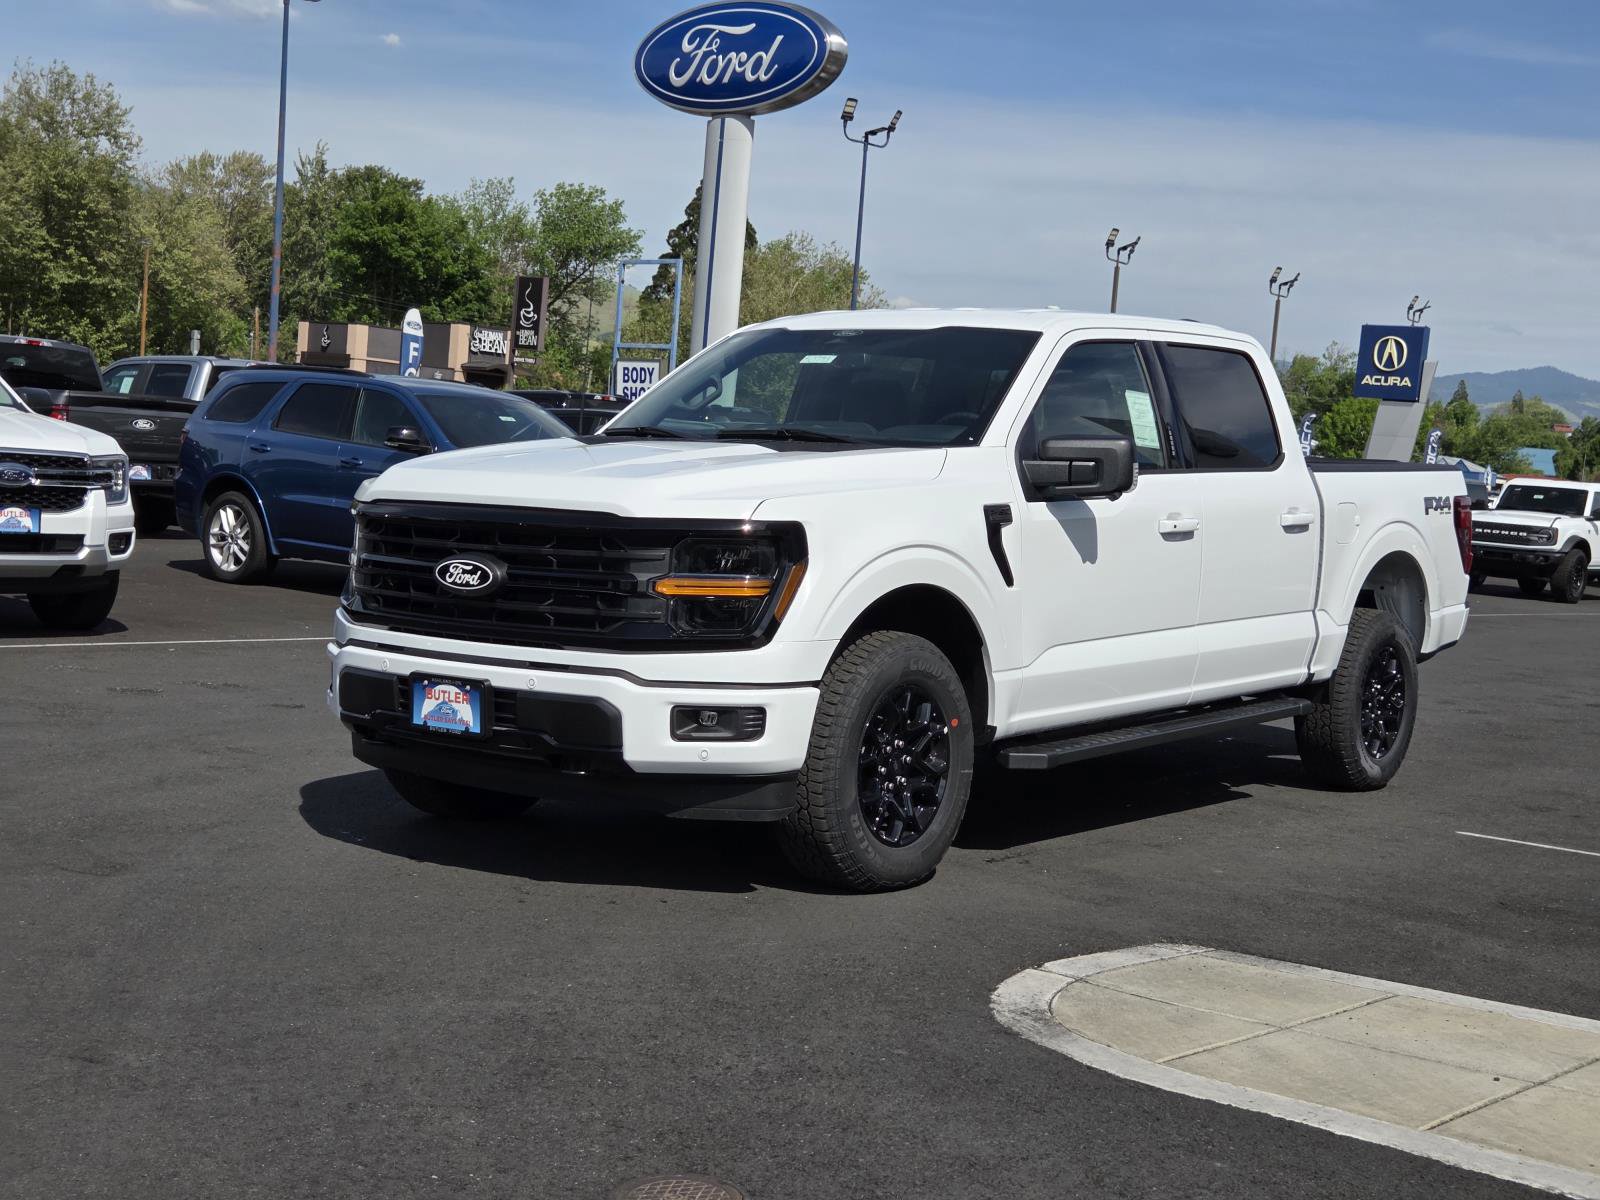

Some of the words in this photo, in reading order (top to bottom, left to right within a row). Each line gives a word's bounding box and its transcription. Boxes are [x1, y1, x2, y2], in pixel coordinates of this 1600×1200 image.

[669, 22, 784, 88] Ford
[482, 330, 503, 339] HUMAN
[519, 335, 537, 346] BEAN
[480, 339, 508, 354] BEAN
[622, 366, 655, 384] BODY
[1361, 375, 1412, 388] ACURA
[622, 386, 651, 401] SHO
[1424, 496, 1452, 515] FX4
[1475, 528, 1527, 537] BRONCO
[446, 563, 482, 586] Ford
[426, 688, 470, 705] BUTLER
